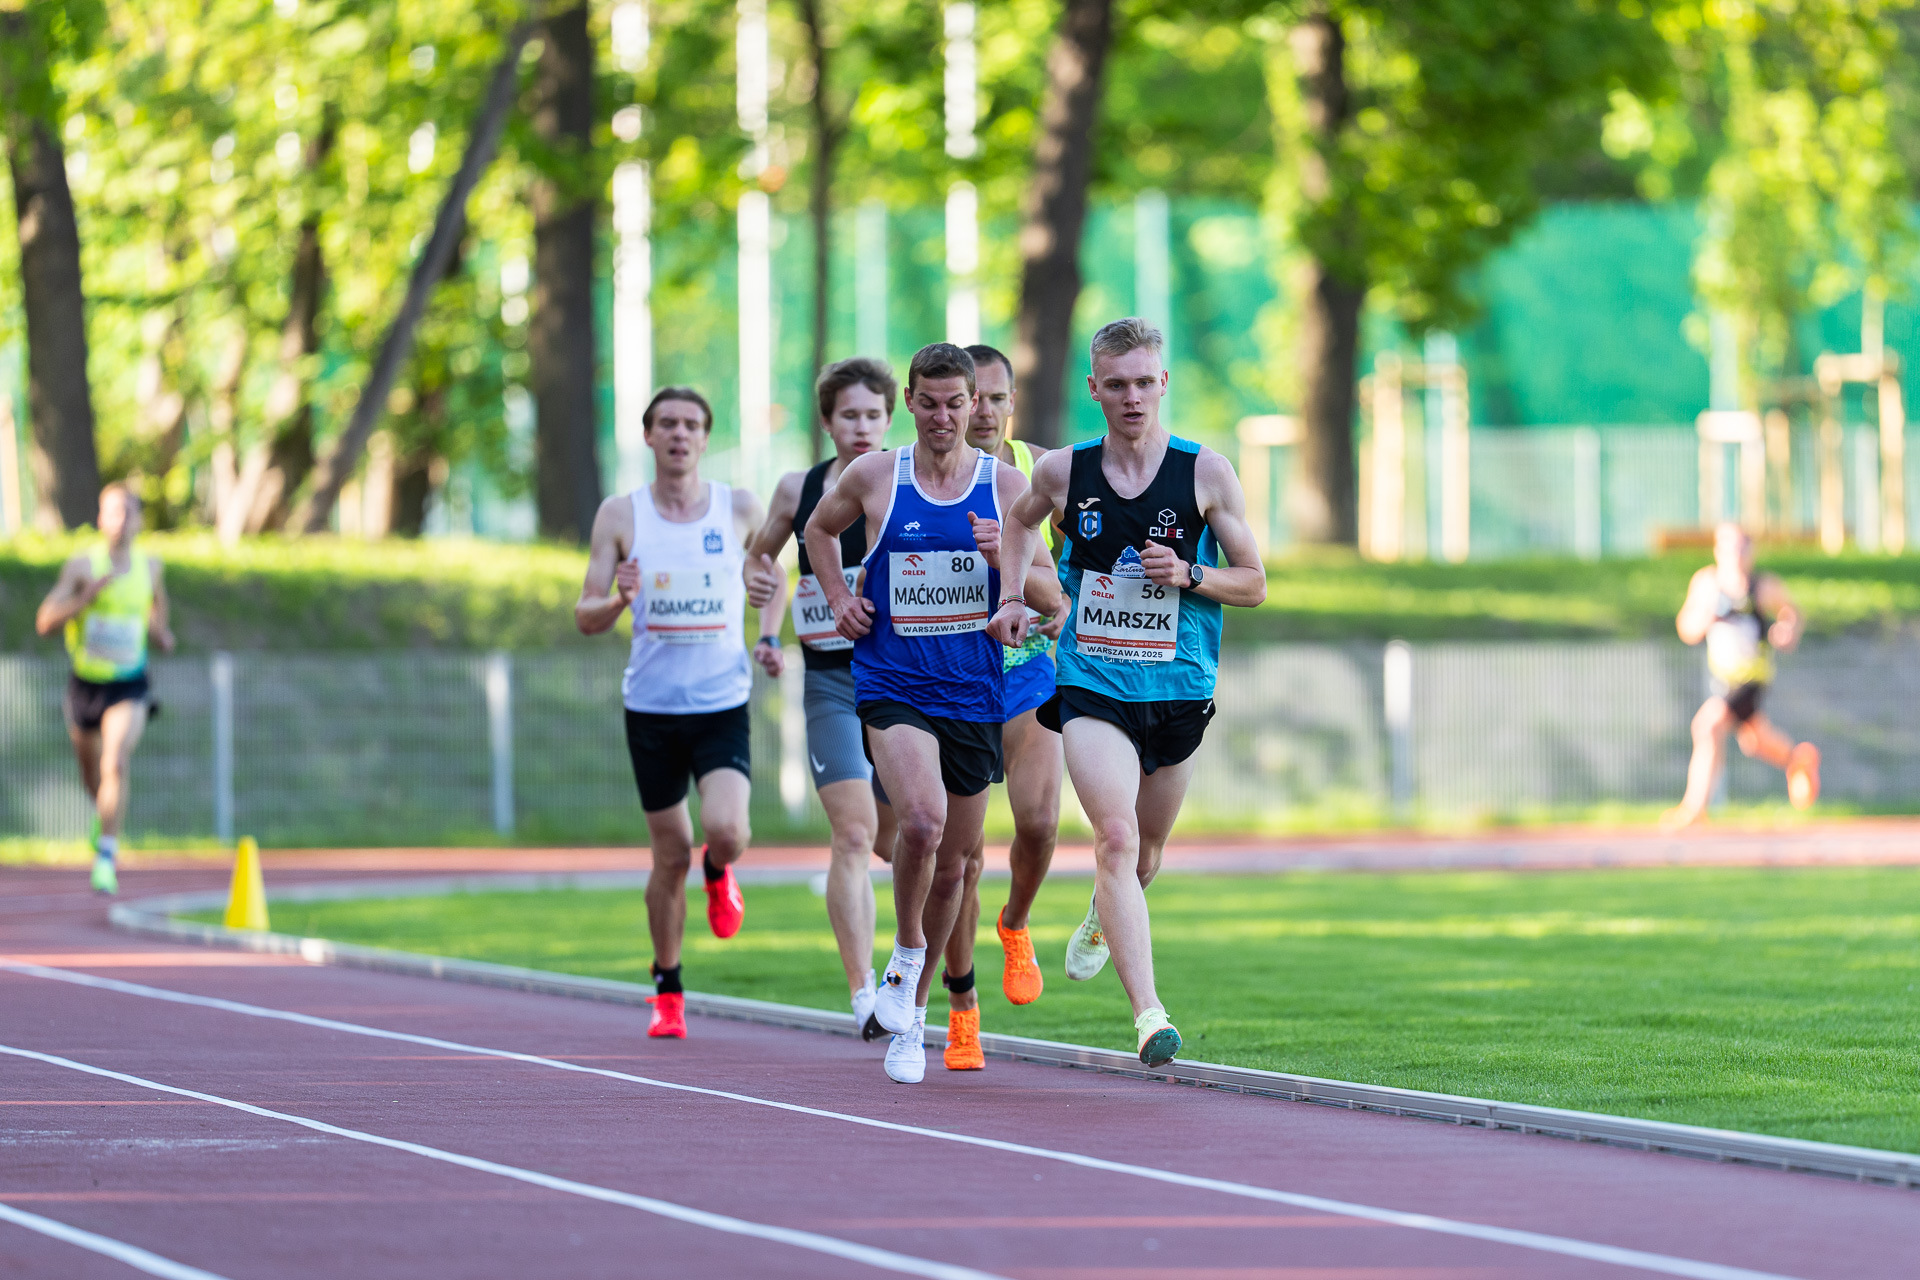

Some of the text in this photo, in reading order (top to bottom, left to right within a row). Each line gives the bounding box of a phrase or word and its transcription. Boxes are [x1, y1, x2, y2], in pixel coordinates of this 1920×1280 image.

[1149, 526, 1183, 539] CUBE
[951, 557, 974, 573] 80
[704, 573, 711, 587] 1
[894, 583, 985, 606] MAĆKOWIAK
[1091, 590, 1115, 600] ORLEN
[1140, 584, 1166, 600] 56
[649, 599, 724, 616] ADAMCZAK
[1083, 606, 1172, 631] MARSZK
[903, 622, 976, 633] WARSZAWA 2025
[1087, 646, 1163, 658] WARSZAWA 2025
